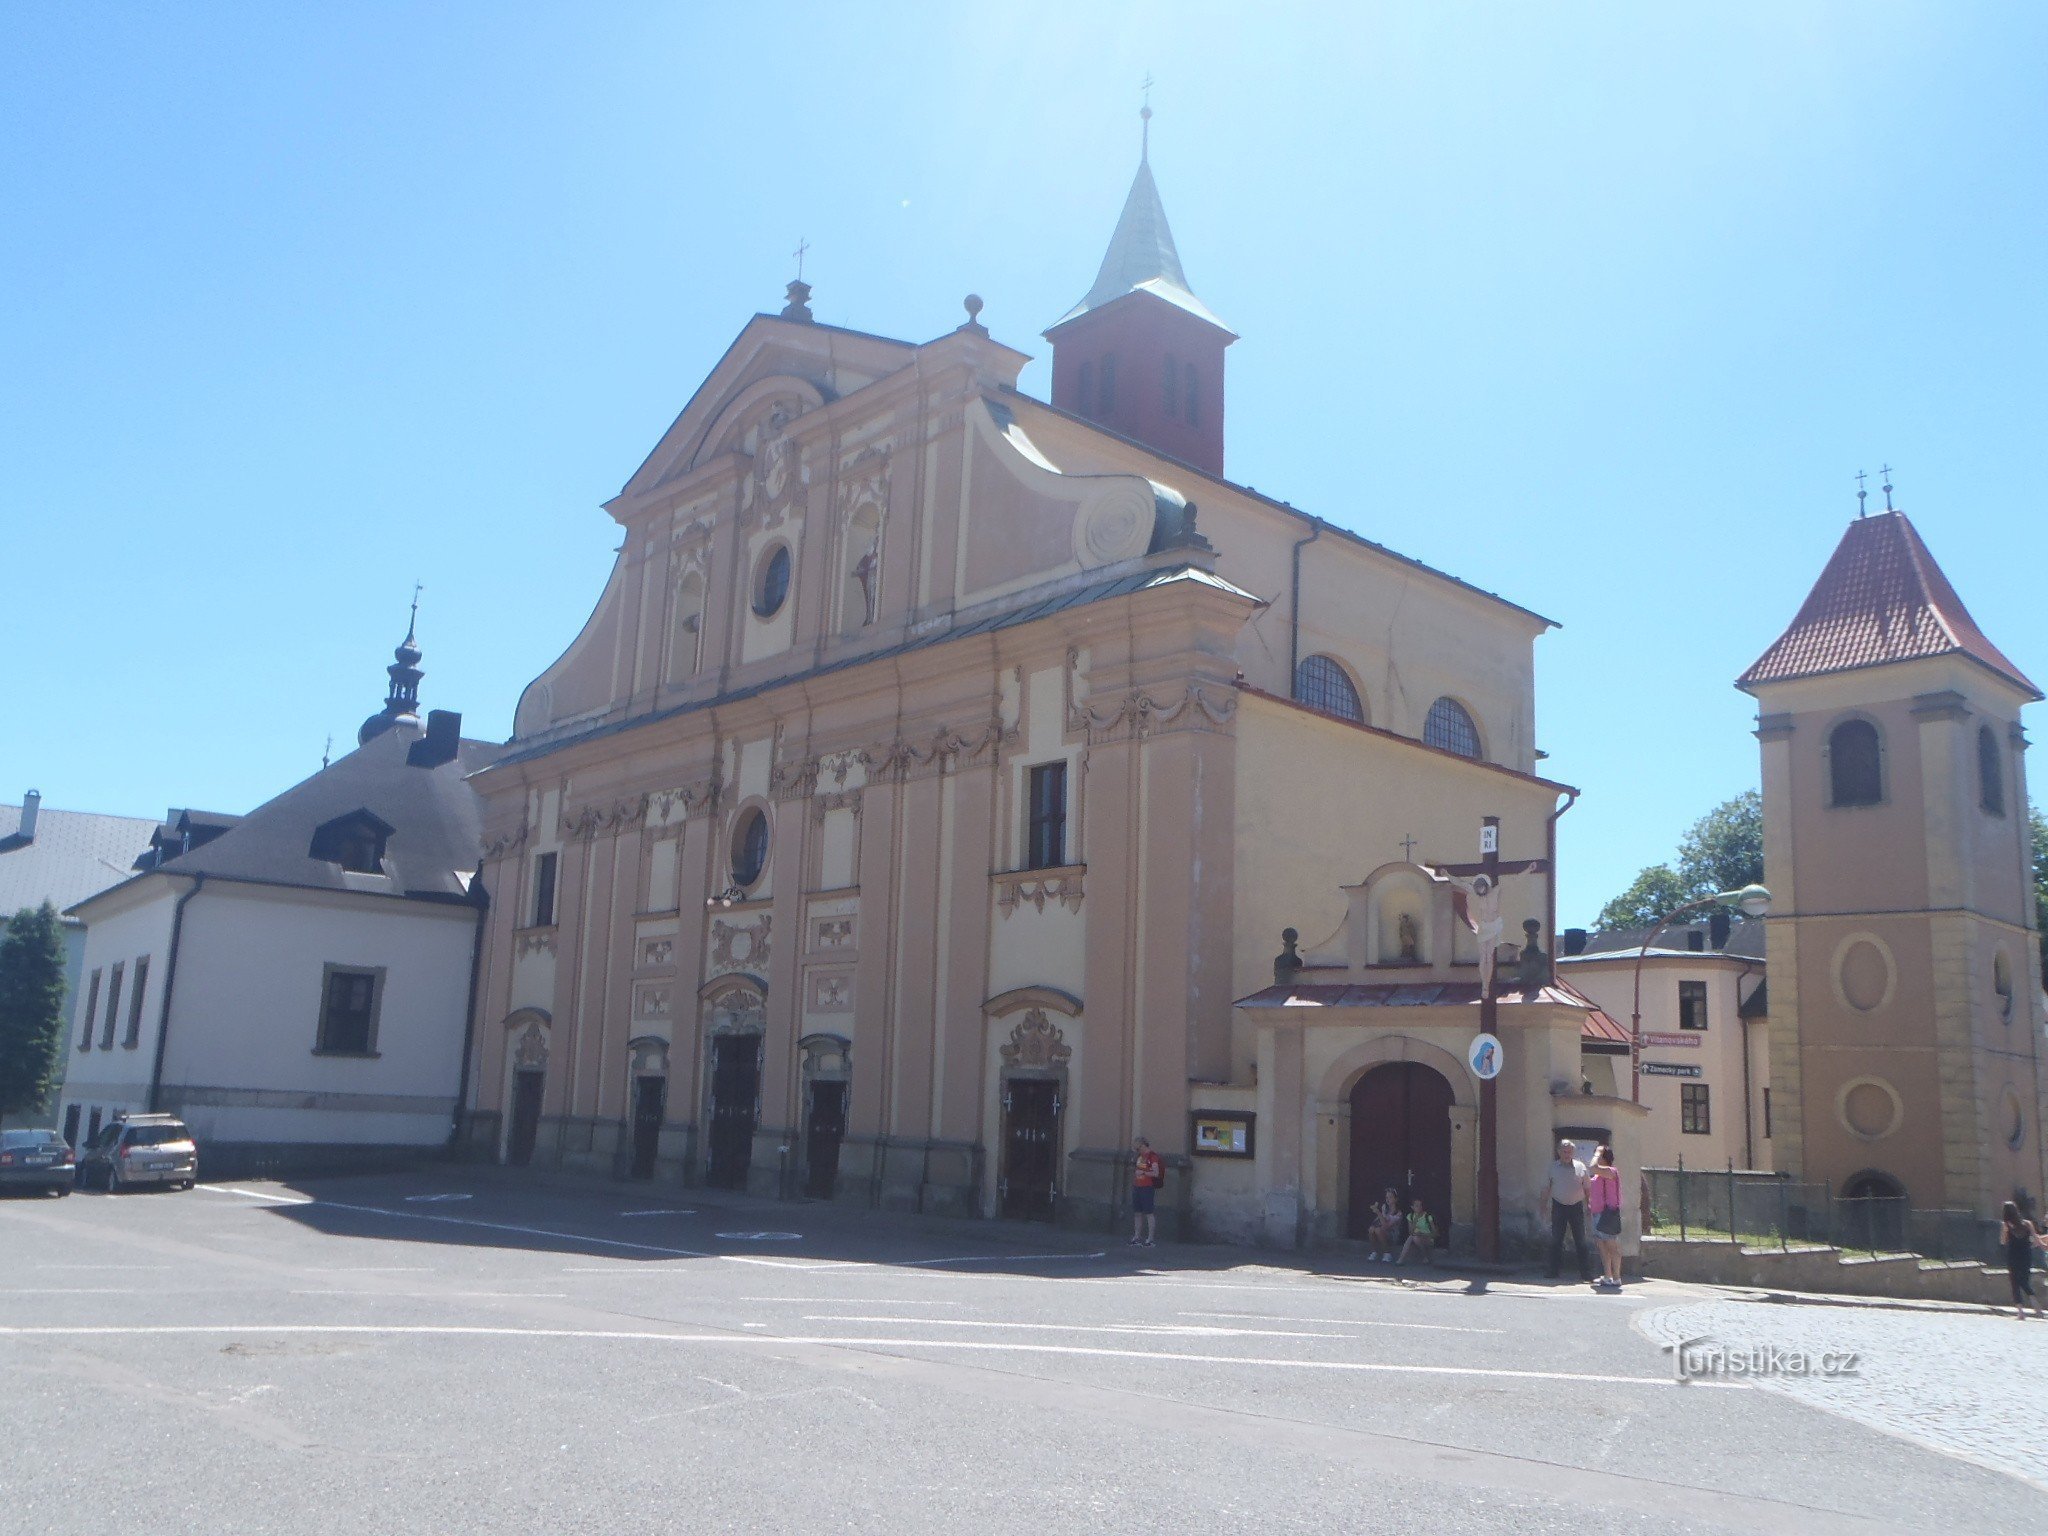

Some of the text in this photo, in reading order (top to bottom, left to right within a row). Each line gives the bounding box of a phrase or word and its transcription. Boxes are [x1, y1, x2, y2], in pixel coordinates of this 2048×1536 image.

[1484, 830, 1492, 838] IN
[1484, 840, 1492, 849] RI
[1677, 1067, 1691, 1076] park
